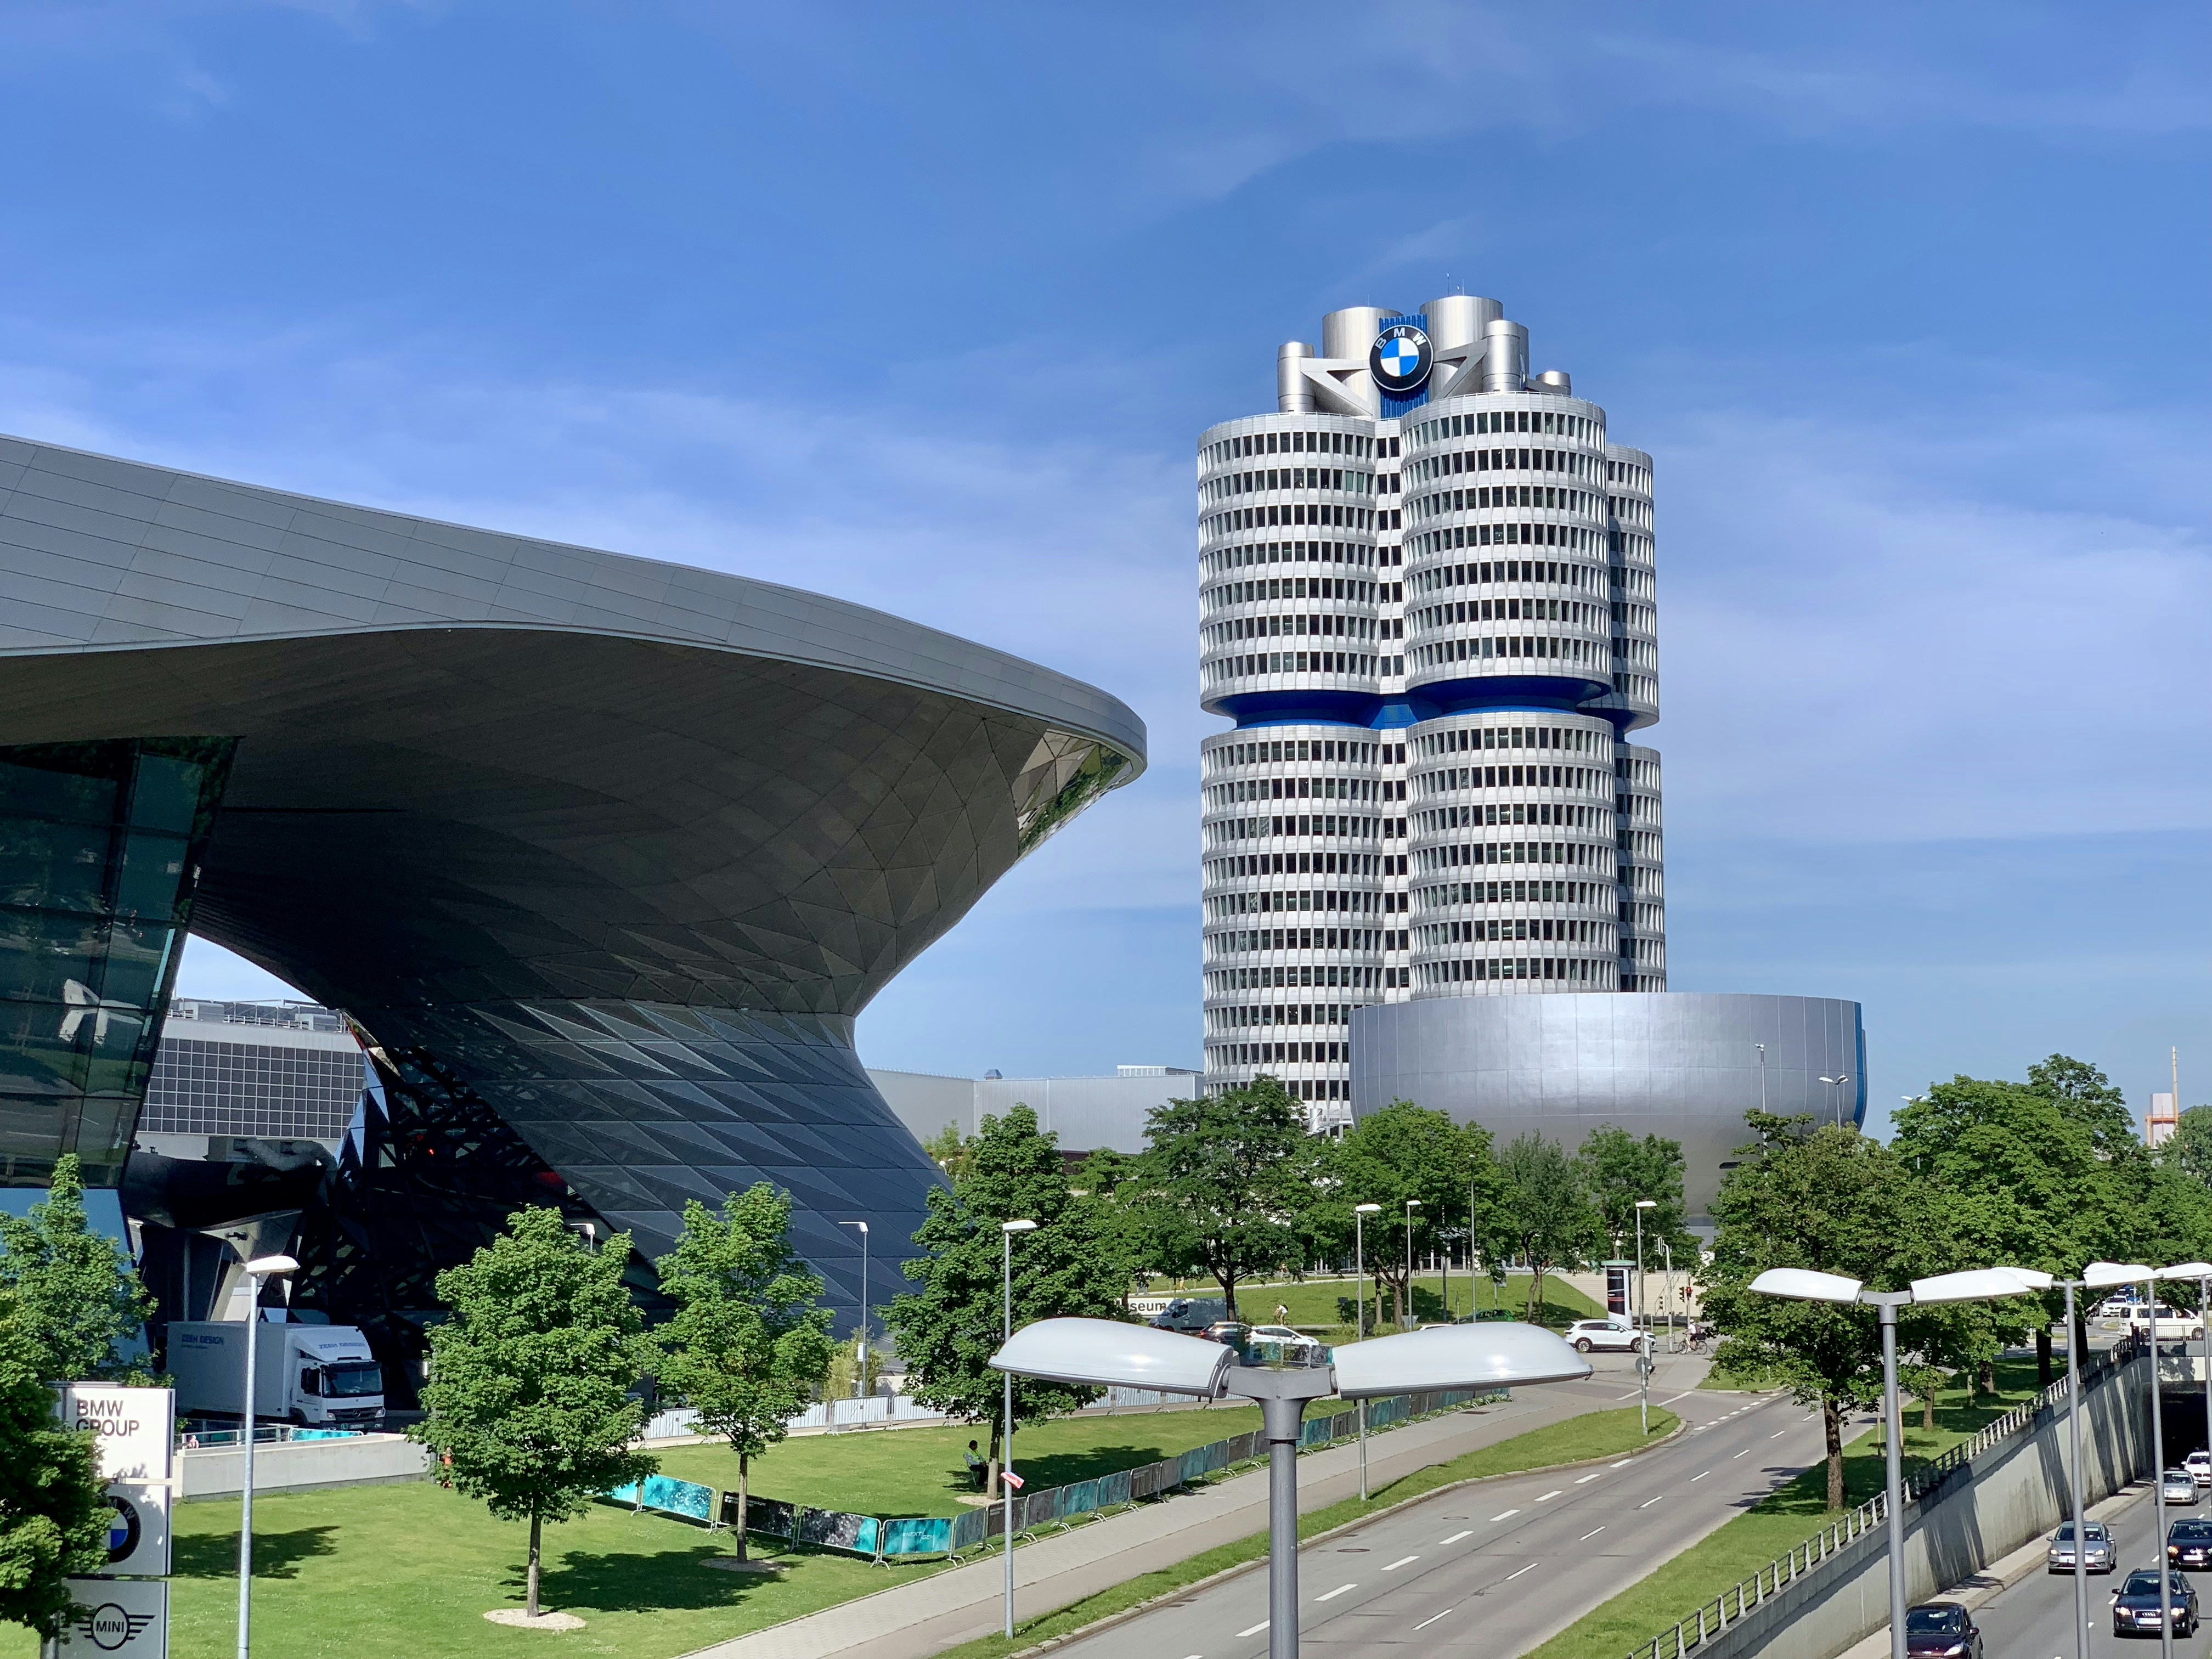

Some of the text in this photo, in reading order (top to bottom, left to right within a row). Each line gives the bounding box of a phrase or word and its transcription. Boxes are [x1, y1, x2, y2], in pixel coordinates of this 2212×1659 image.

[1375, 327, 1427, 350] BMW
[76, 1399, 123, 1417] BMW
[96, 1621, 125, 1633] MINI
